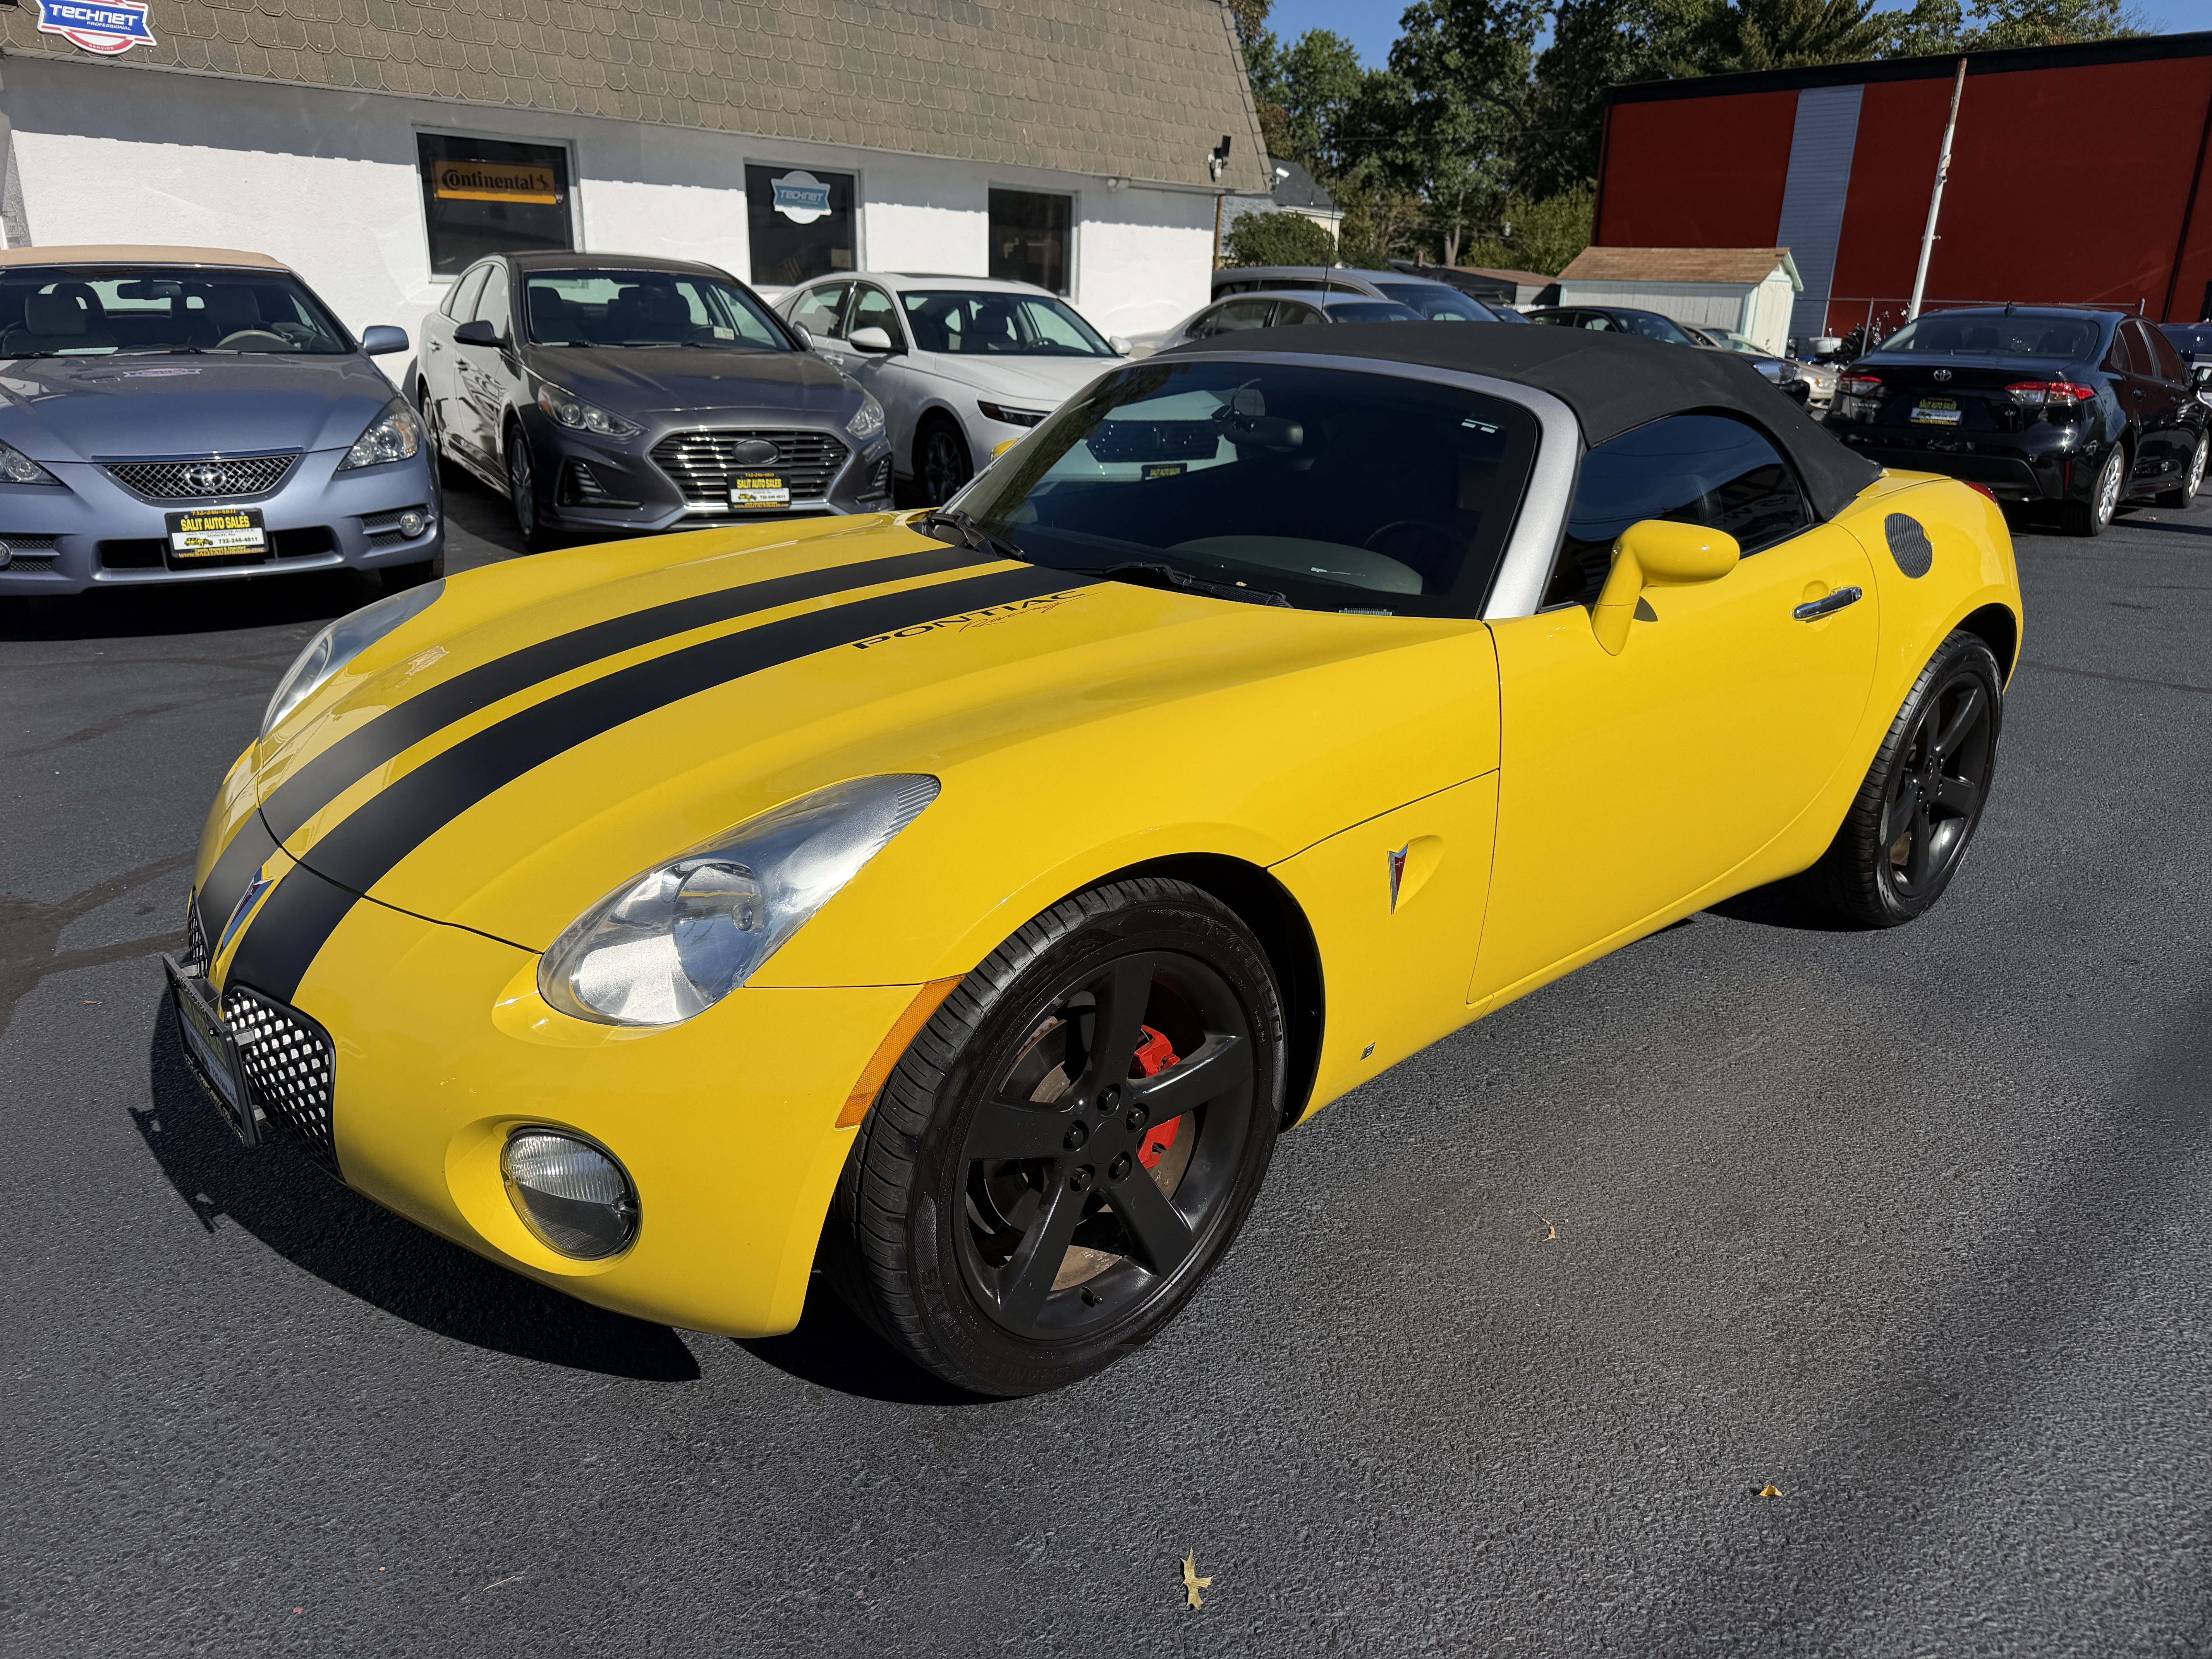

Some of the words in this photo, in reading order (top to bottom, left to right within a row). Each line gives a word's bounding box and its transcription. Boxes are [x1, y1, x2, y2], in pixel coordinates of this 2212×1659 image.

[86, 21, 132, 31] PROFESSIONAL
[442, 169, 534, 190] Continental
[737, 479, 751, 489] SALIT
[752, 478, 765, 488] AUTO
[766, 478, 782, 488] SALES
[180, 518, 203, 531] SALIT
[204, 517, 225, 530] AUTO
[225, 515, 251, 528] SALES
[852, 591, 1085, 649] PONTIAC
[958, 592, 1102, 633] Racing
